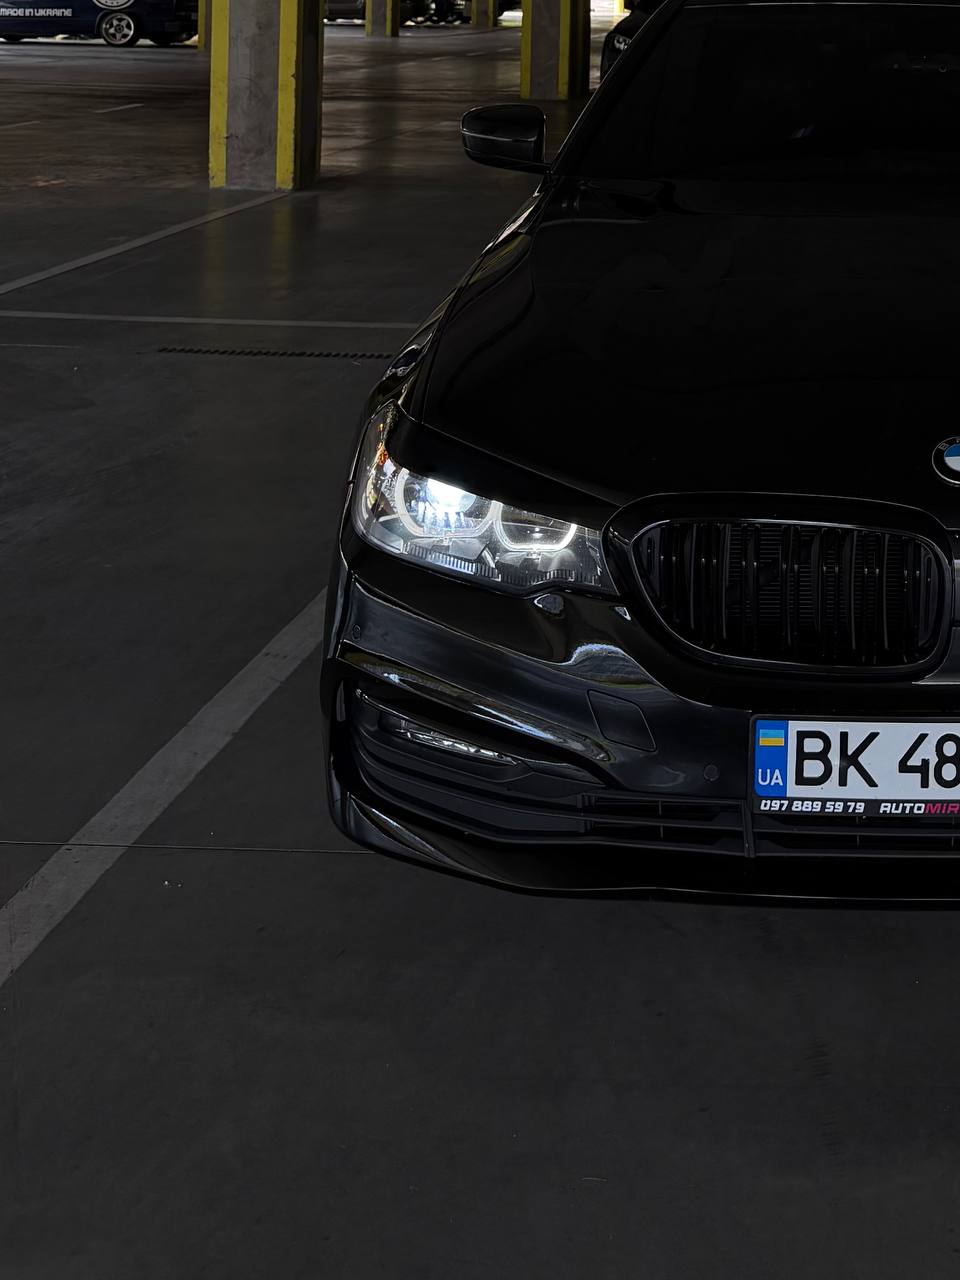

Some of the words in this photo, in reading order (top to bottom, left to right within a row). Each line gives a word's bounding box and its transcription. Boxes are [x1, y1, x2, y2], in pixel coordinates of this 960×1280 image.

[795, 730, 880, 787] BK
[758, 769, 784, 786] UA
[760, 799, 789, 811] 097
[791, 800, 822, 812] 889
[825, 801, 844, 813] 59
[847, 802, 866, 813] 79
